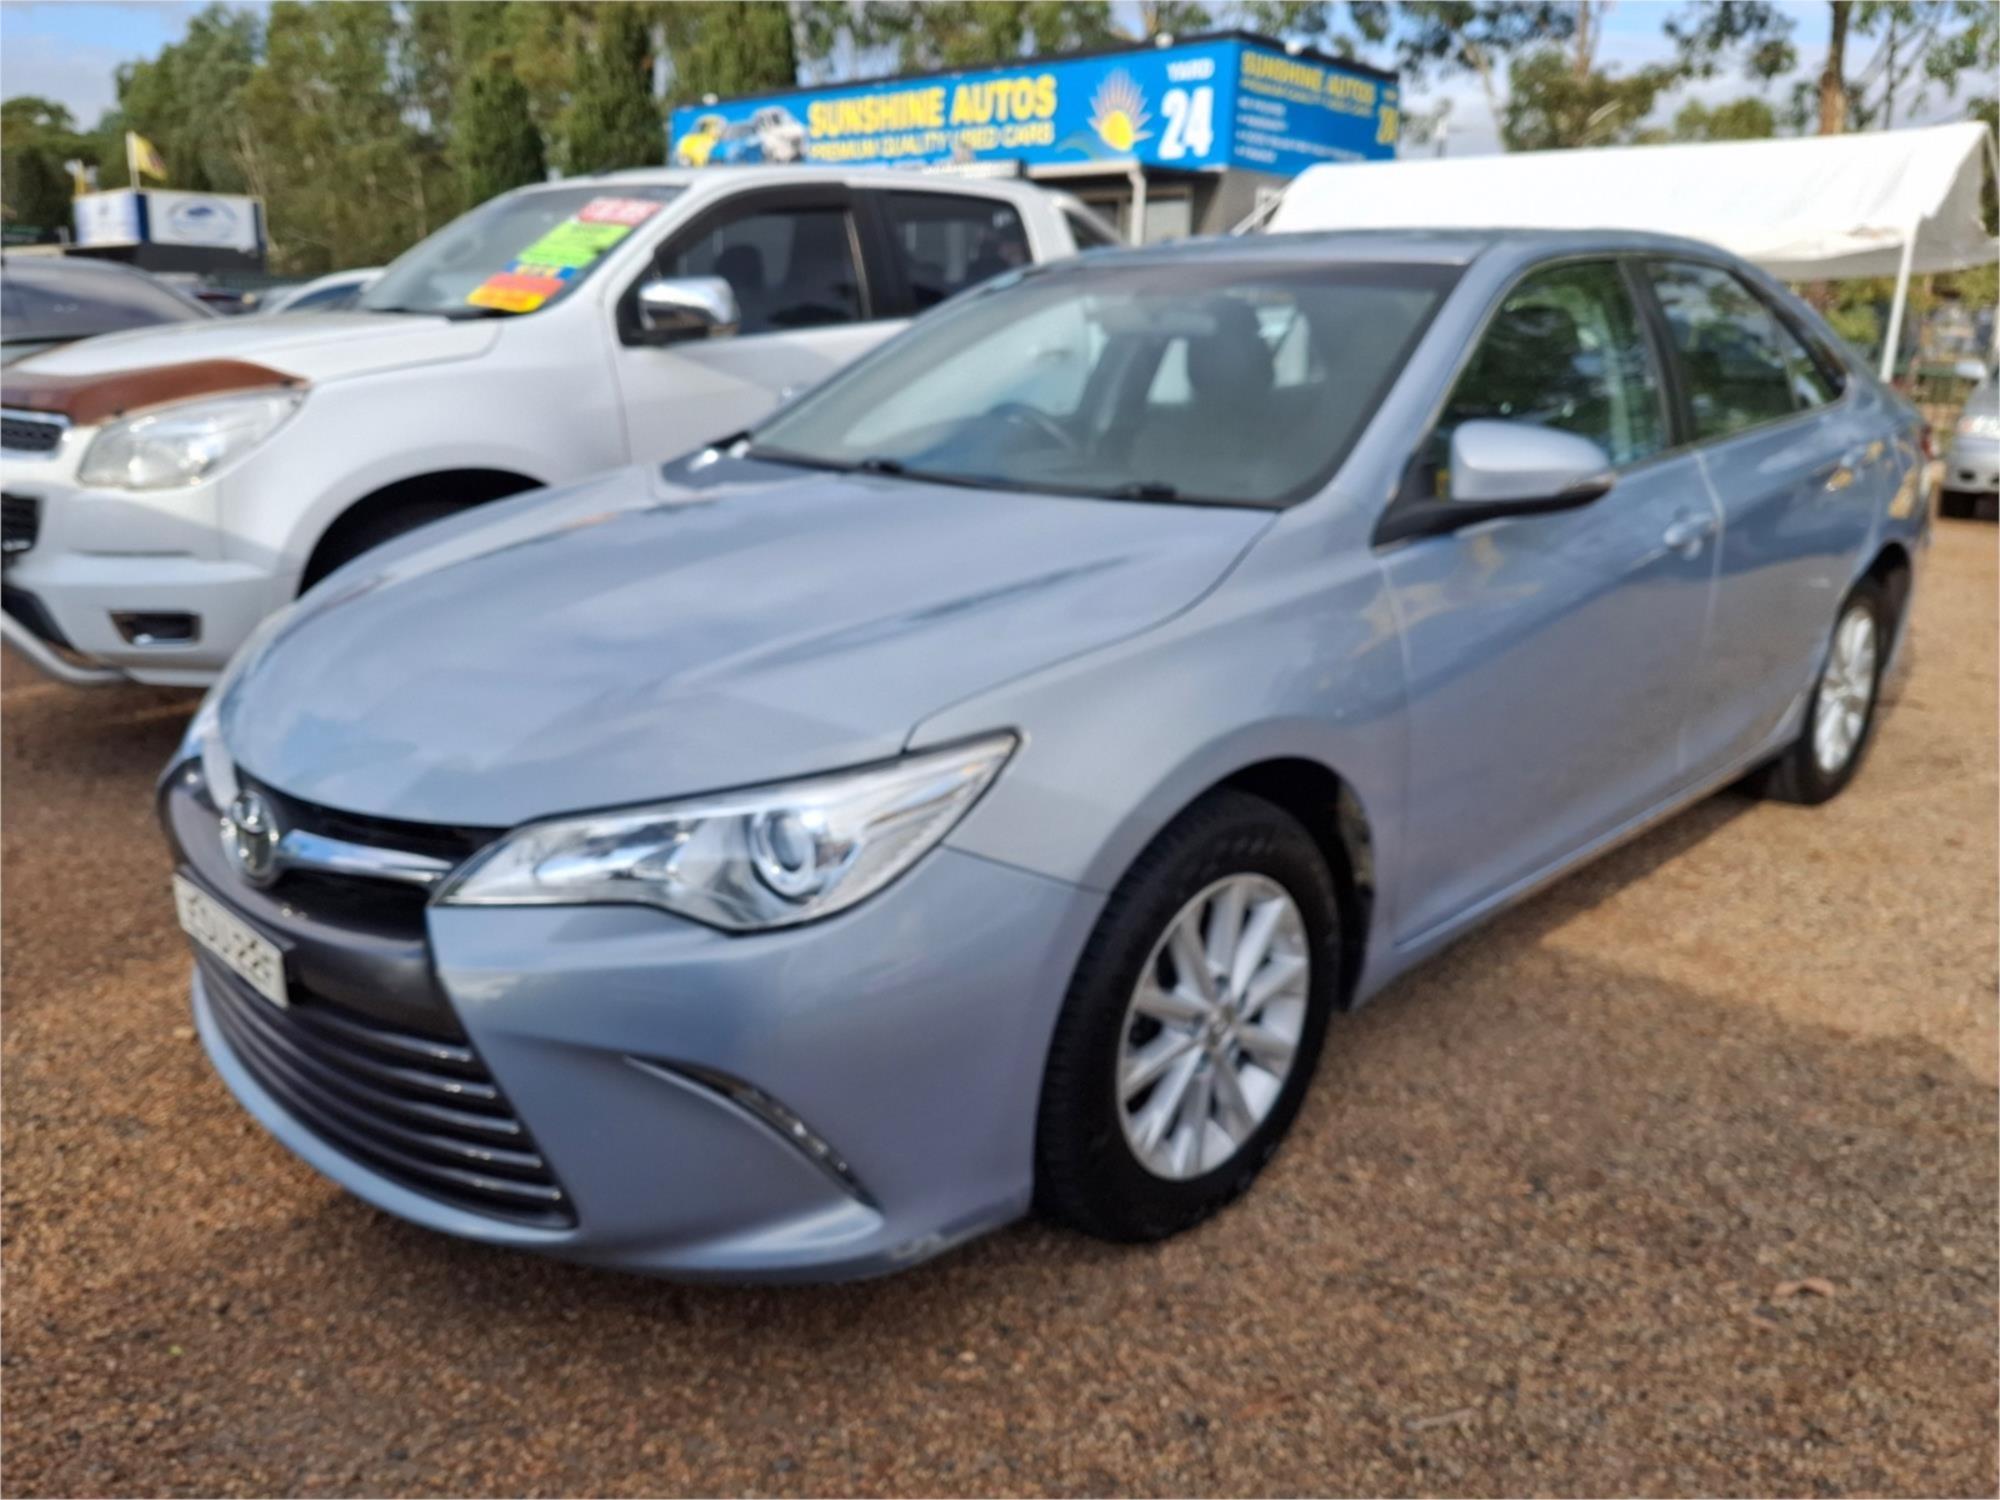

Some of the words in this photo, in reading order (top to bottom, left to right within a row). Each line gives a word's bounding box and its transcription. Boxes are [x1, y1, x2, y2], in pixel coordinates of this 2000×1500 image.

[1166, 58, 1215, 82] YARD
[807, 87, 945, 137] SUNSHINE
[950, 74, 1056, 124] AUTOS
[1158, 86, 1214, 159] 24
[1001, 121, 1055, 147] CARS
